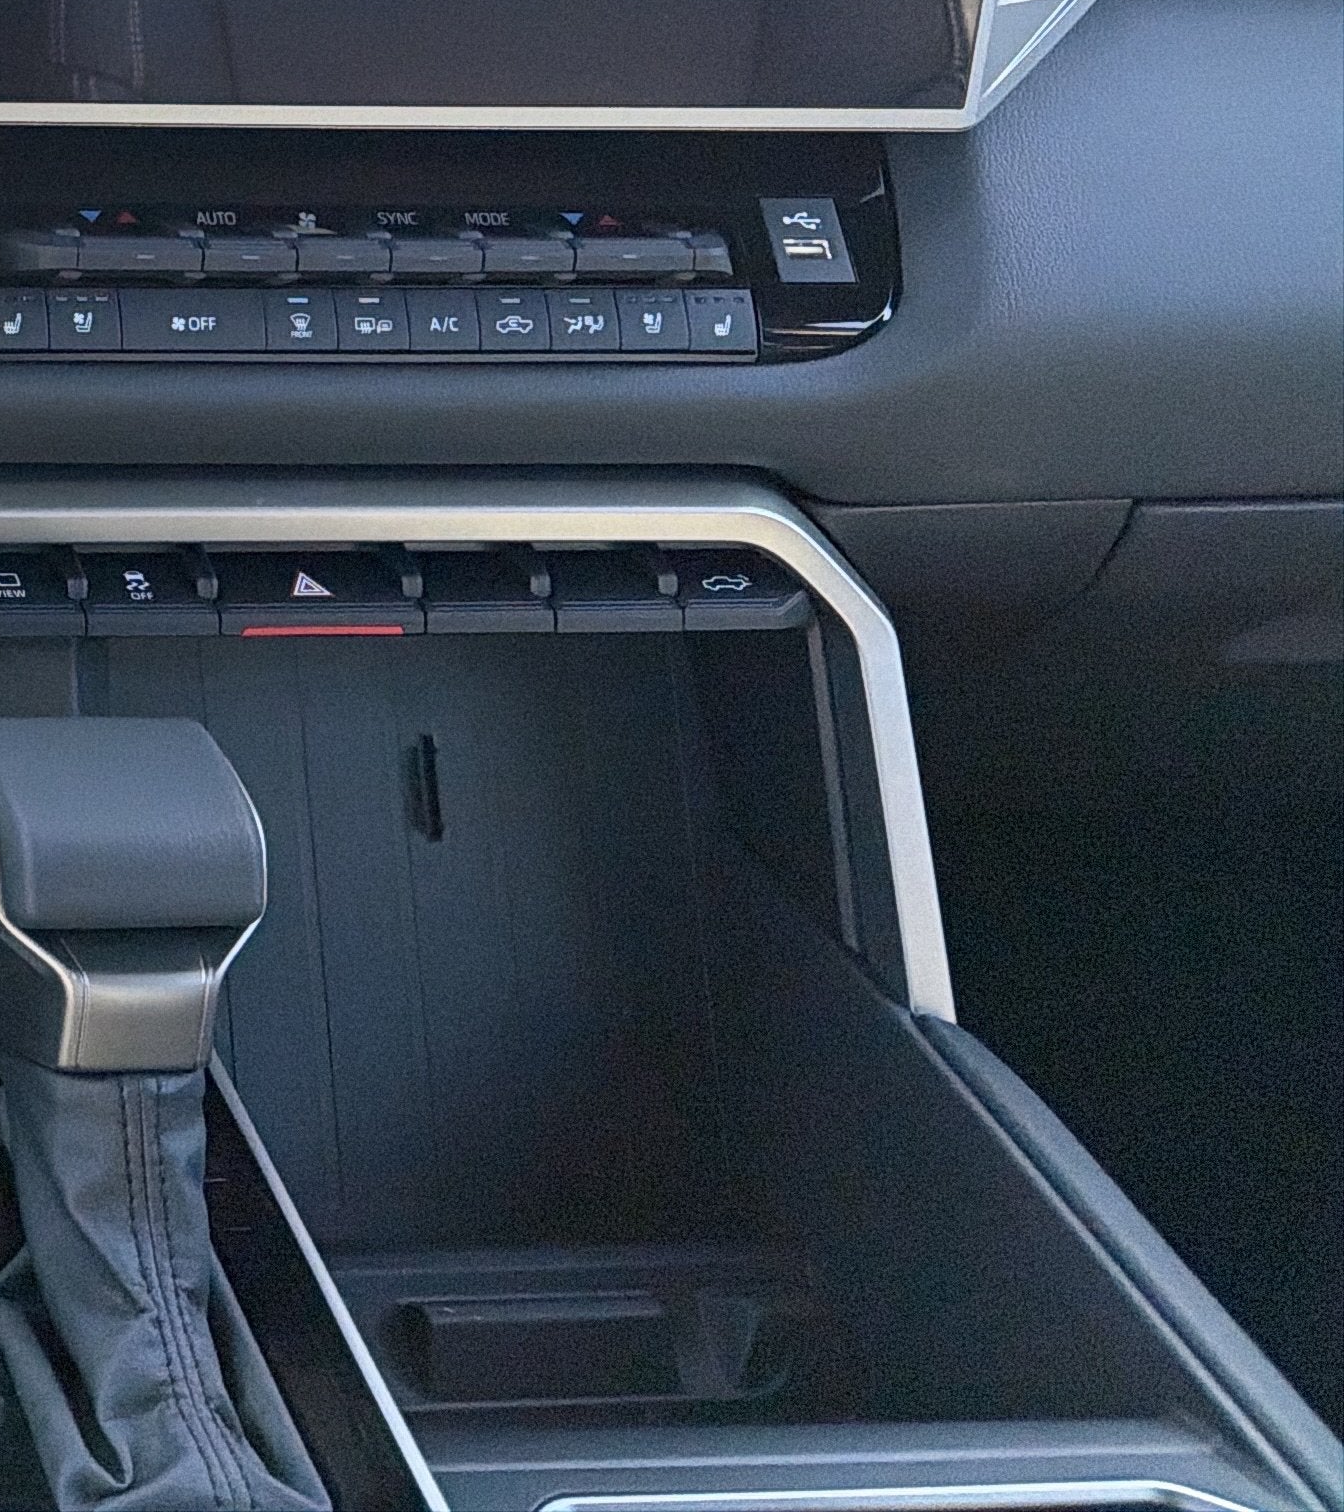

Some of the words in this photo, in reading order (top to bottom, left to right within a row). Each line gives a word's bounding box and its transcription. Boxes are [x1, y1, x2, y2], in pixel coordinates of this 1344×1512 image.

[196, 210, 237, 226] AUTO
[376, 211, 419, 226] SYNC
[464, 211, 510, 227] MODE
[188, 316, 217, 331] OFF
[429, 317, 460, 333] A/C
[130, 591, 154, 600] OFF
